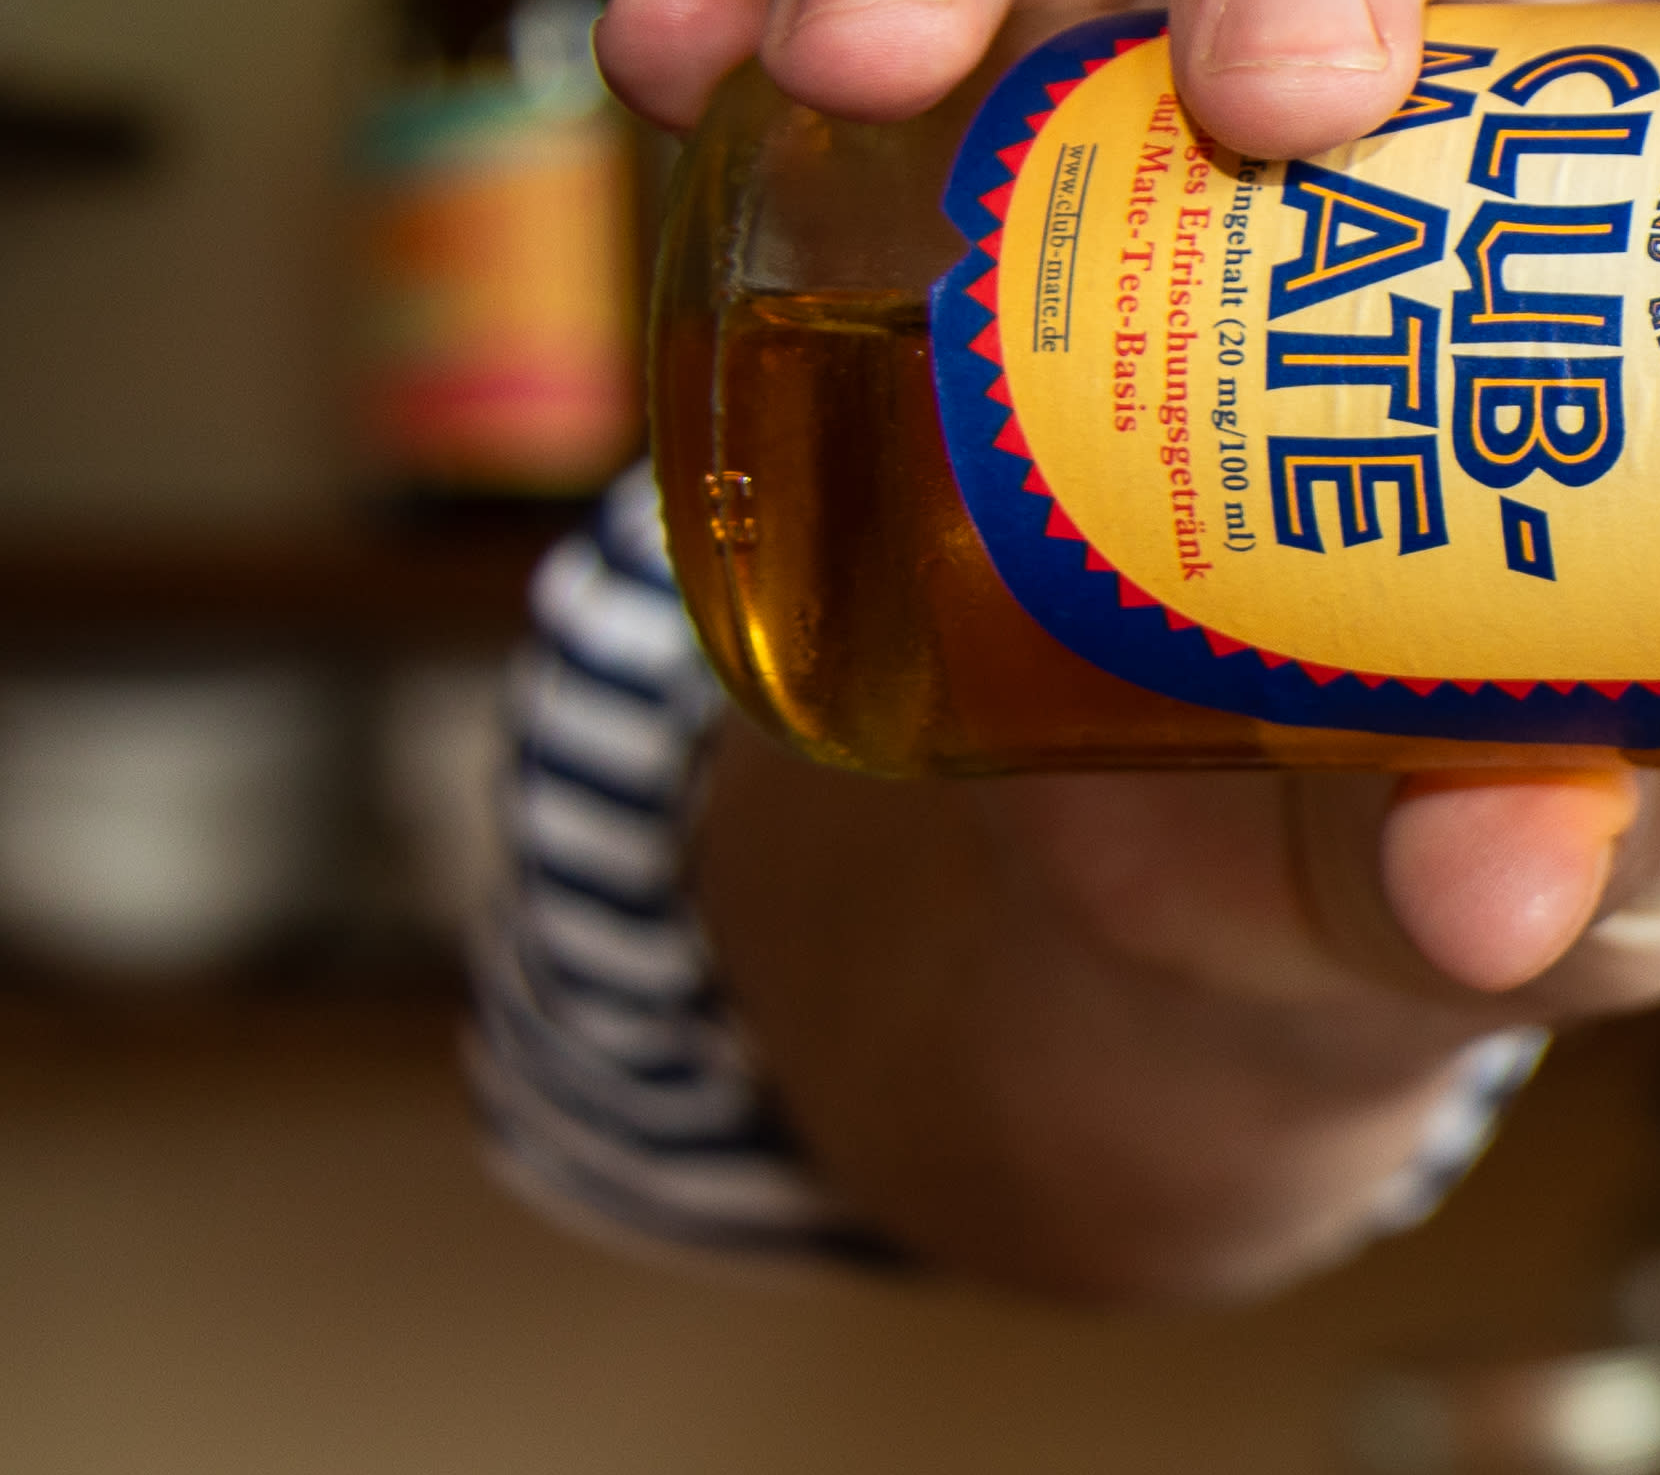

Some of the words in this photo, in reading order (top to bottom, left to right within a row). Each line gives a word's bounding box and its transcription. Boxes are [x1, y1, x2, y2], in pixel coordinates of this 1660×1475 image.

[1146, 92, 1181, 138] auf
[1040, 143, 1086, 353] www.club-mate.de
[1113, 142, 1171, 434] Mate-Tee-Basis
[1219, 159, 1265, 309] feingehalt
[1158, 204, 1213, 581] Erfrischungsgetränk
[1214, 317, 1247, 366] (20
[1210, 373, 1251, 492] mg/100
[1222, 501, 1256, 553] ml)
